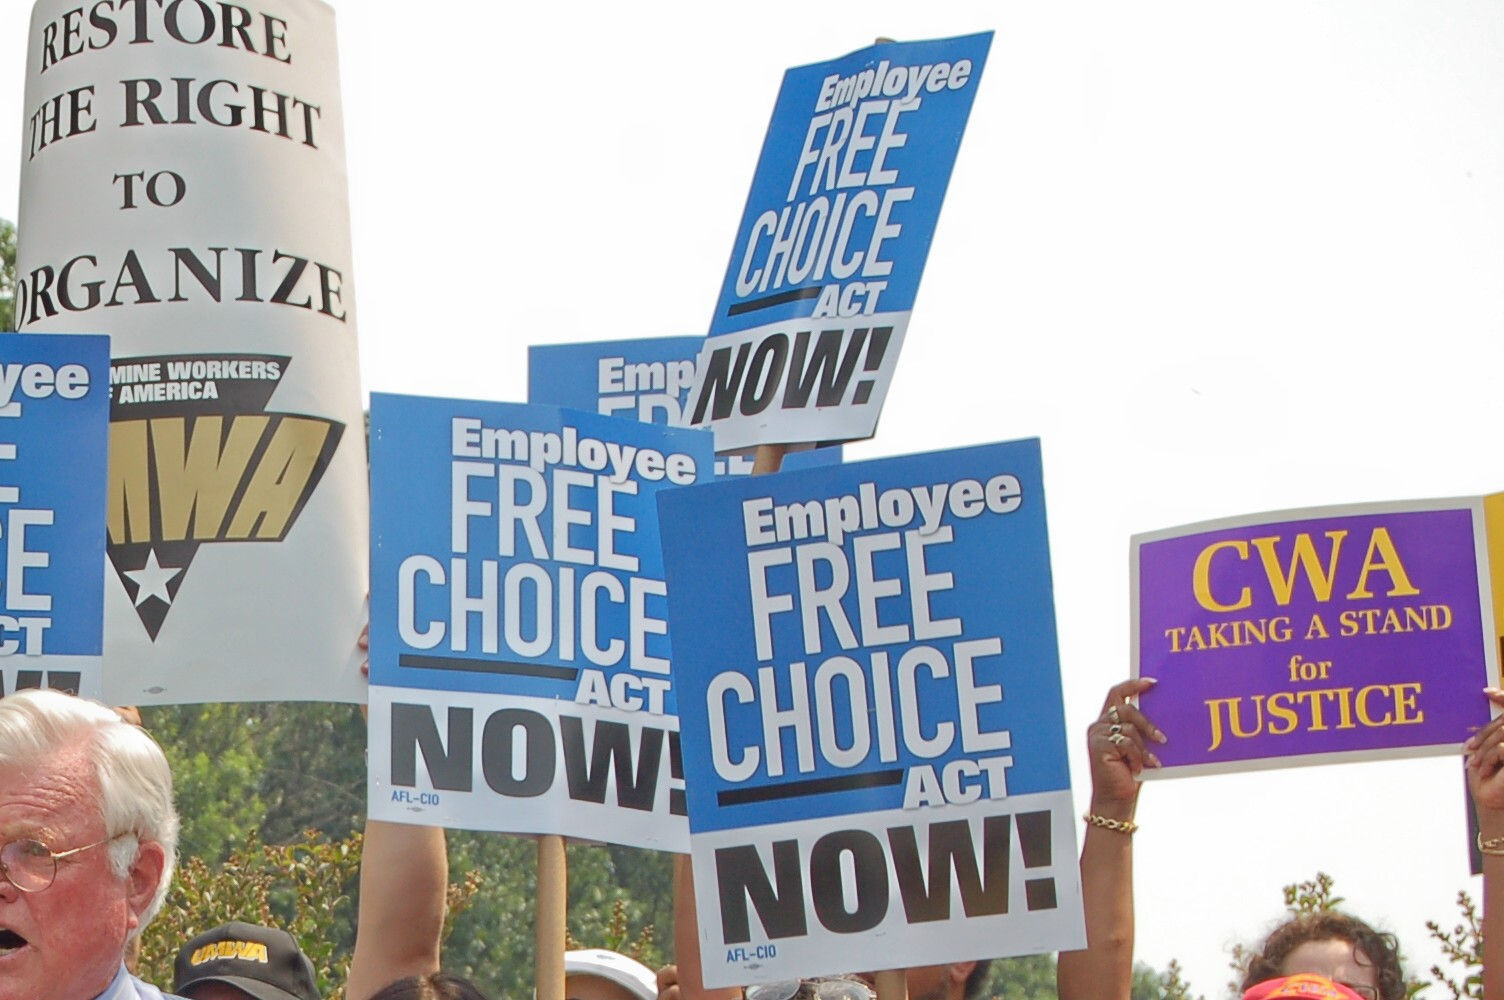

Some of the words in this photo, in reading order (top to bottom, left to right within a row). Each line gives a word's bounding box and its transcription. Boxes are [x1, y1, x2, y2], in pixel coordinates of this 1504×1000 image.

[39, 0, 291, 74] RESTORE
[29, 85, 97, 162] THE
[118, 77, 320, 150] RIGHT
[815, 59, 972, 112] Employee
[786, 97, 921, 202] FREE
[113, 170, 186, 209] TO
[735, 187, 915, 297] CHOICE
[811, 282, 887, 319] ACT
[111, 363, 161, 384] MINE
[168, 360, 281, 381] WORKERS
[118, 381, 219, 404] AMERICA
[691, 326, 894, 426] NOW!
[452, 417, 696, 485] Employee
[452, 460, 639, 572] FREE
[742, 473, 1021, 546] Employee
[747, 525, 962, 661] FREE
[1192, 527, 1420, 613] CWA
[398, 555, 671, 674] CHOICE
[1165, 617, 1292, 653] TAKING
[1305, 614, 1329, 639] A
[1340, 604, 1453, 636] STAND
[575, 669, 671, 714] ACT
[1289, 655, 1332, 682] for
[706, 637, 1011, 782] CHOICE
[1205, 683, 1424, 752] JUSTICE
[391, 702, 688, 817] NOW!
[903, 756, 1013, 810] ACT
[391, 790, 440, 806] AFL-CIO
[715, 810, 1058, 945] NOW!
[726, 945, 777, 963] AFL-CIO
